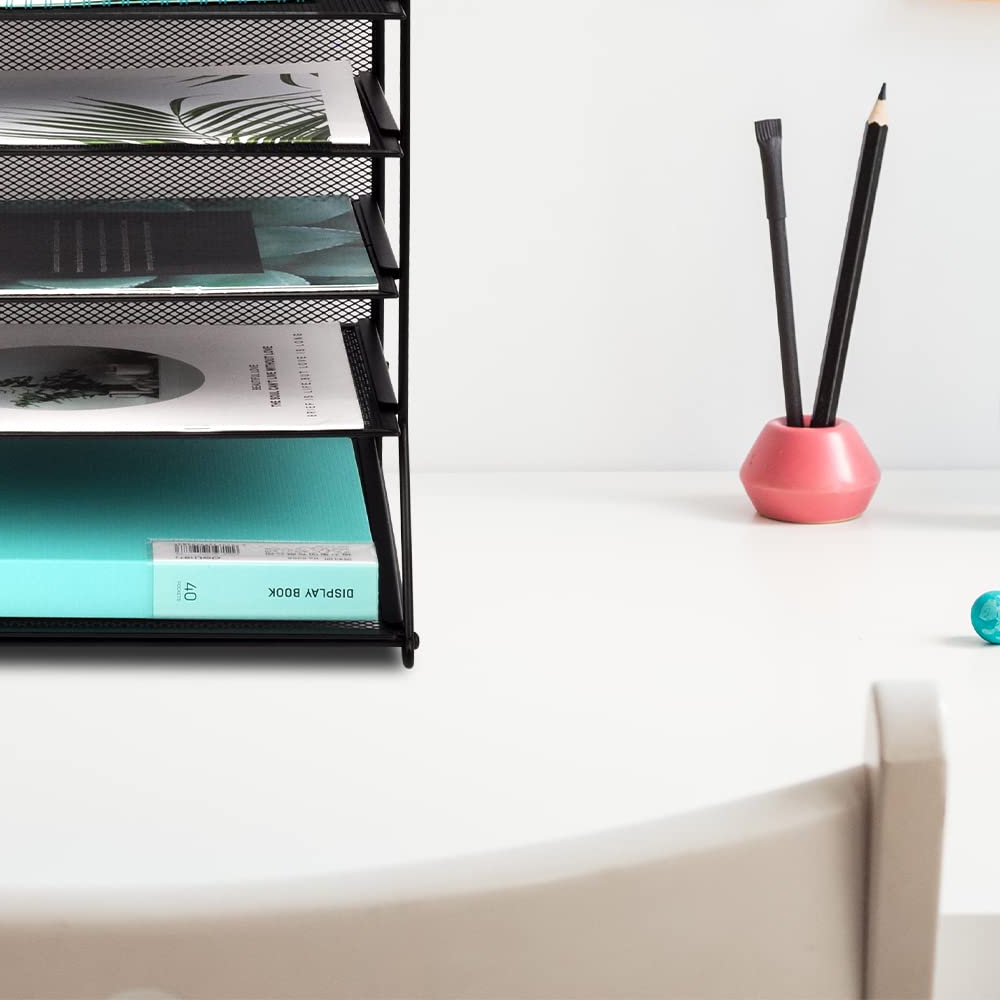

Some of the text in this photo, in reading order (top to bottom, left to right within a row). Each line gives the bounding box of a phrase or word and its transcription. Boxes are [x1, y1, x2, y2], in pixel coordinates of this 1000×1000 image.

[262, 345, 274, 356] LOVE
[264, 355, 275, 371] WITHOUT
[266, 371, 277, 380] LIVE
[269, 391, 281, 400] SOUL
[270, 400, 281, 408] THE
[184, 582, 197, 601] 40
[268, 587, 354, 599] DISPLAY BOOK
